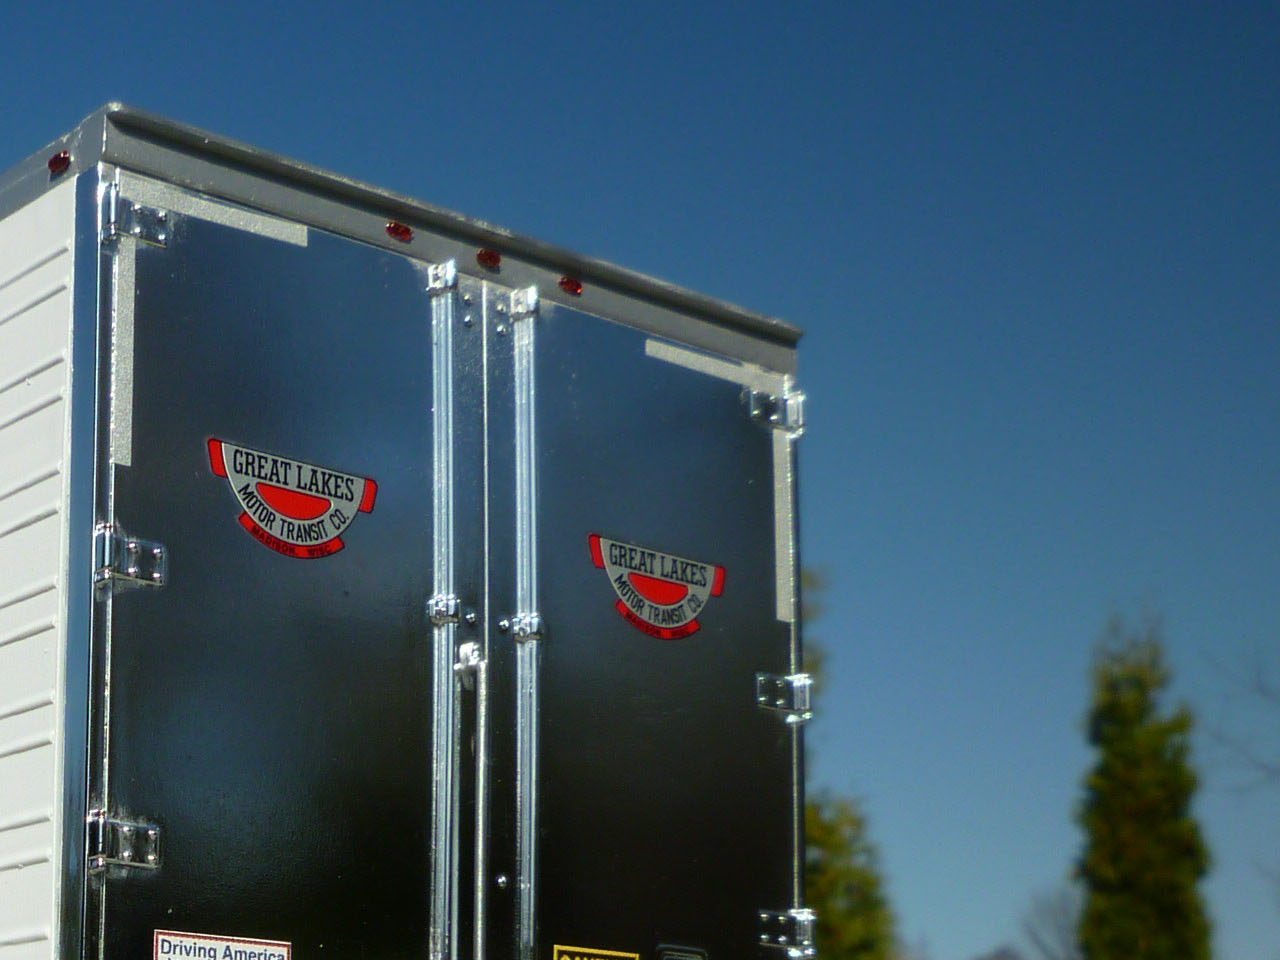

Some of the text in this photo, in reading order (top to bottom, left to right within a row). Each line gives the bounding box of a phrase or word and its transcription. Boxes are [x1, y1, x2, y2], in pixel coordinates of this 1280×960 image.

[233, 449, 354, 502] GREAT LAKES
[238, 483, 350, 543] MOTOR TRANSIT CO.
[609, 543, 707, 587] GREAT LAKES
[614, 573, 645, 616] MOTOR
[648, 604, 687, 625] TRANSIT
